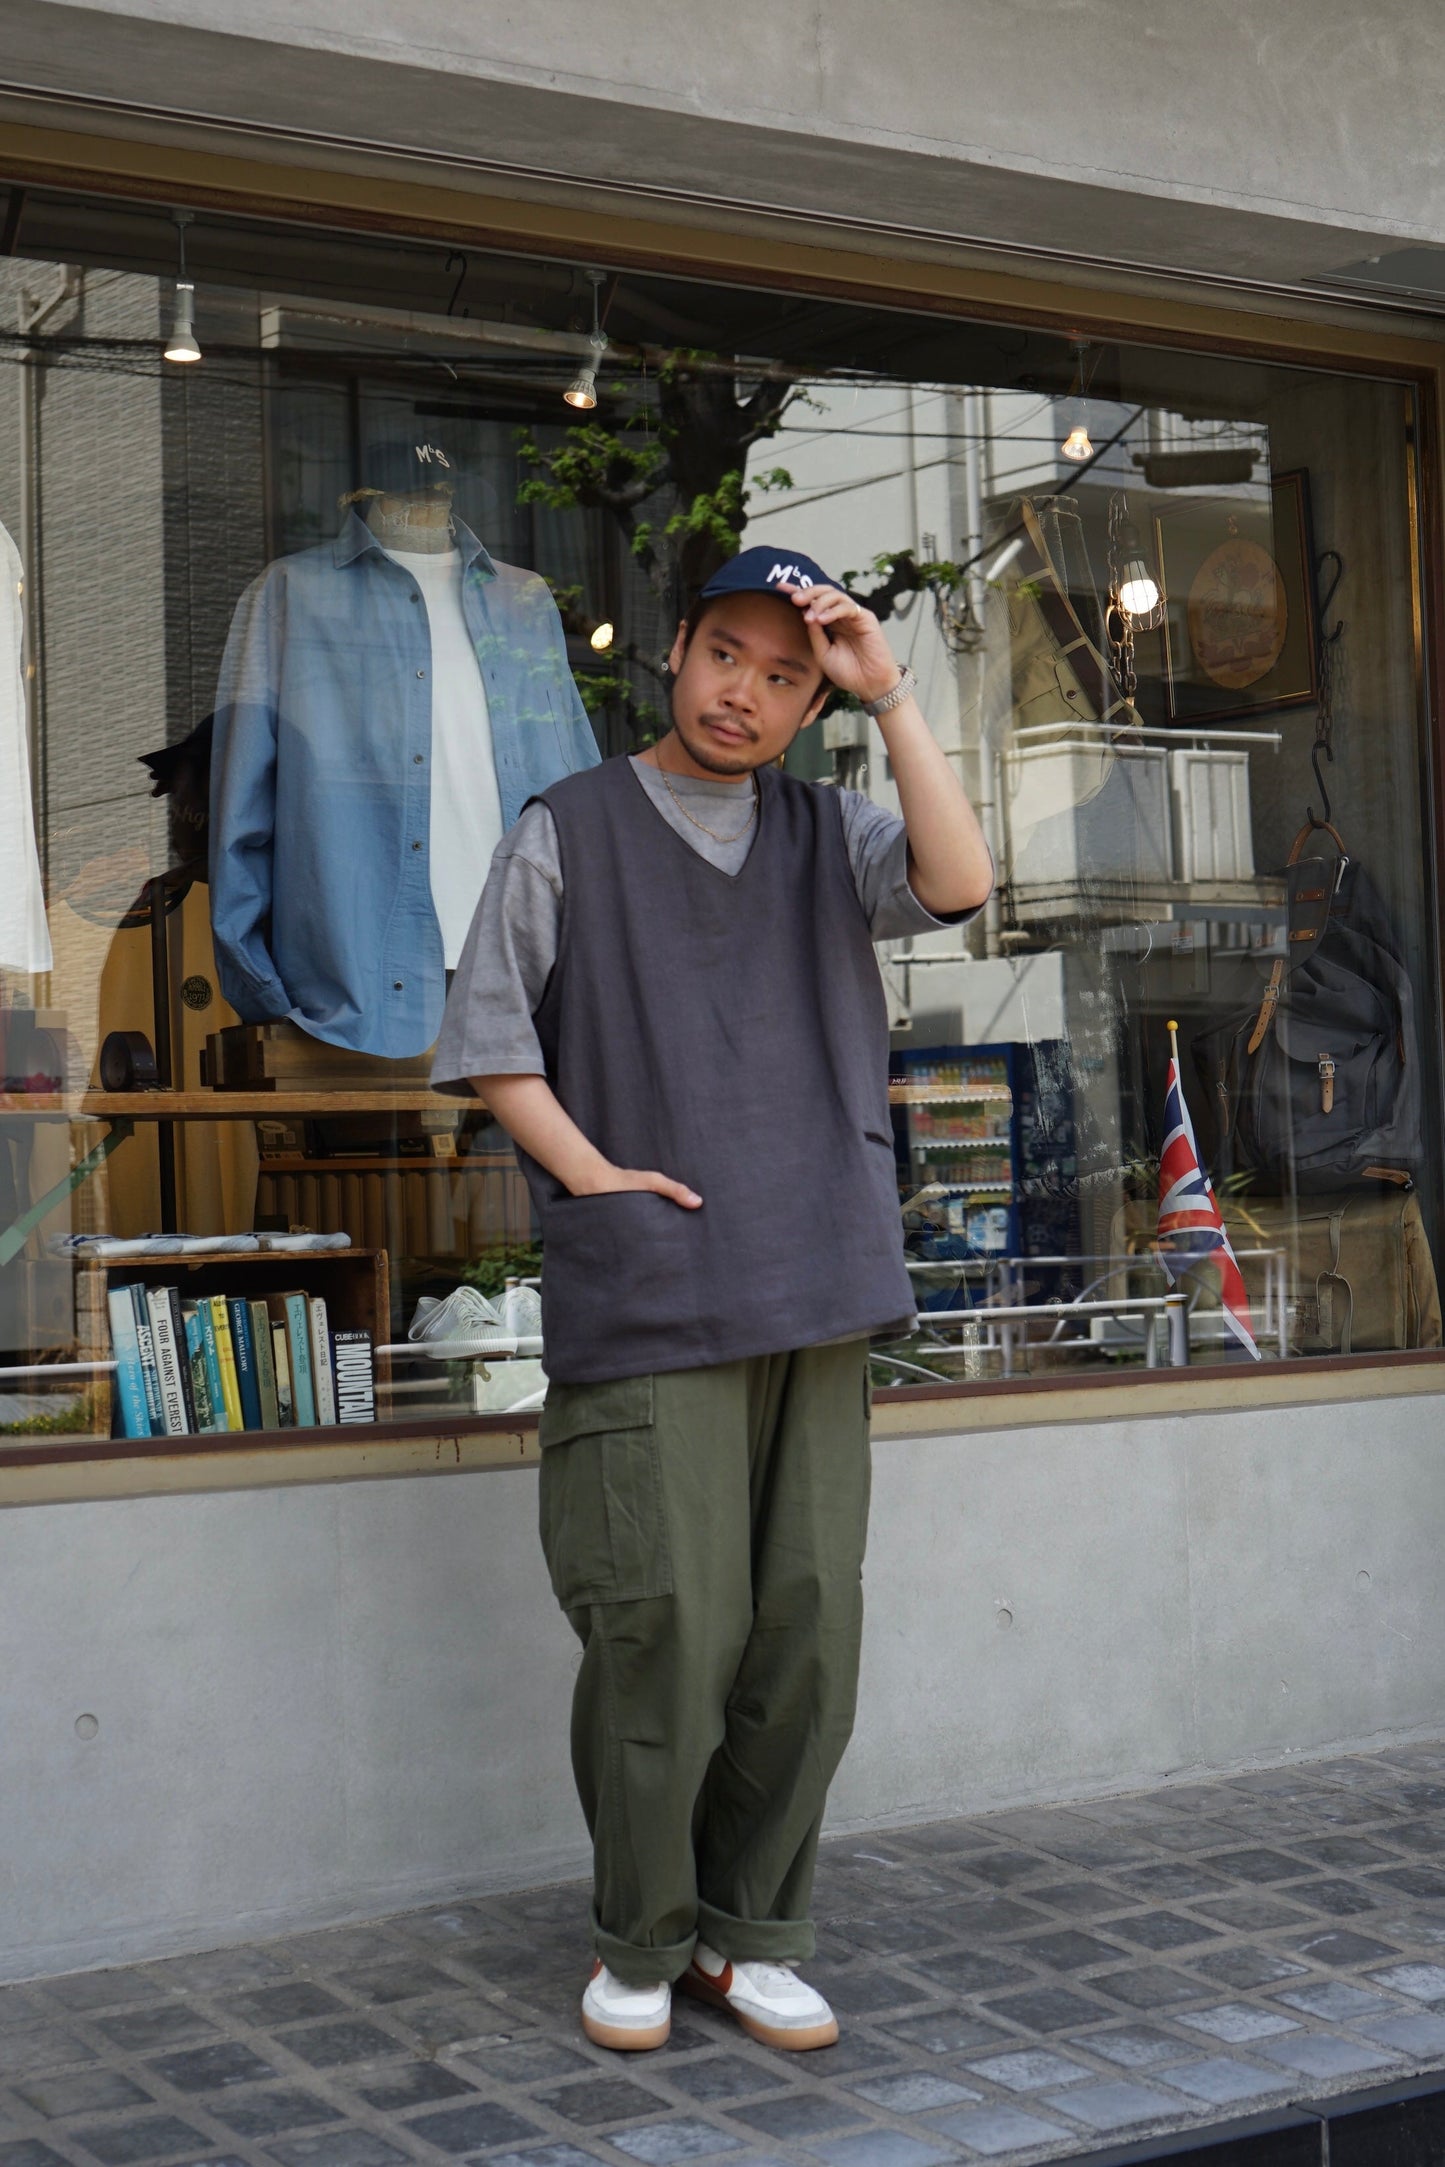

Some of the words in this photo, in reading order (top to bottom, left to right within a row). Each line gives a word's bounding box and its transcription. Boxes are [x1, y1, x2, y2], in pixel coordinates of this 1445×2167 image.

[157, 1319, 169, 1344] FOUR
[234, 1303, 243, 1336] GEORGE
[136, 1325, 155, 1367] ASCENT
[237, 1336, 248, 1372] MALLORY
[161, 1348, 176, 1387] AGAINST
[132, 1395, 142, 1409] the
[166, 1392, 183, 1434] EVEREST
